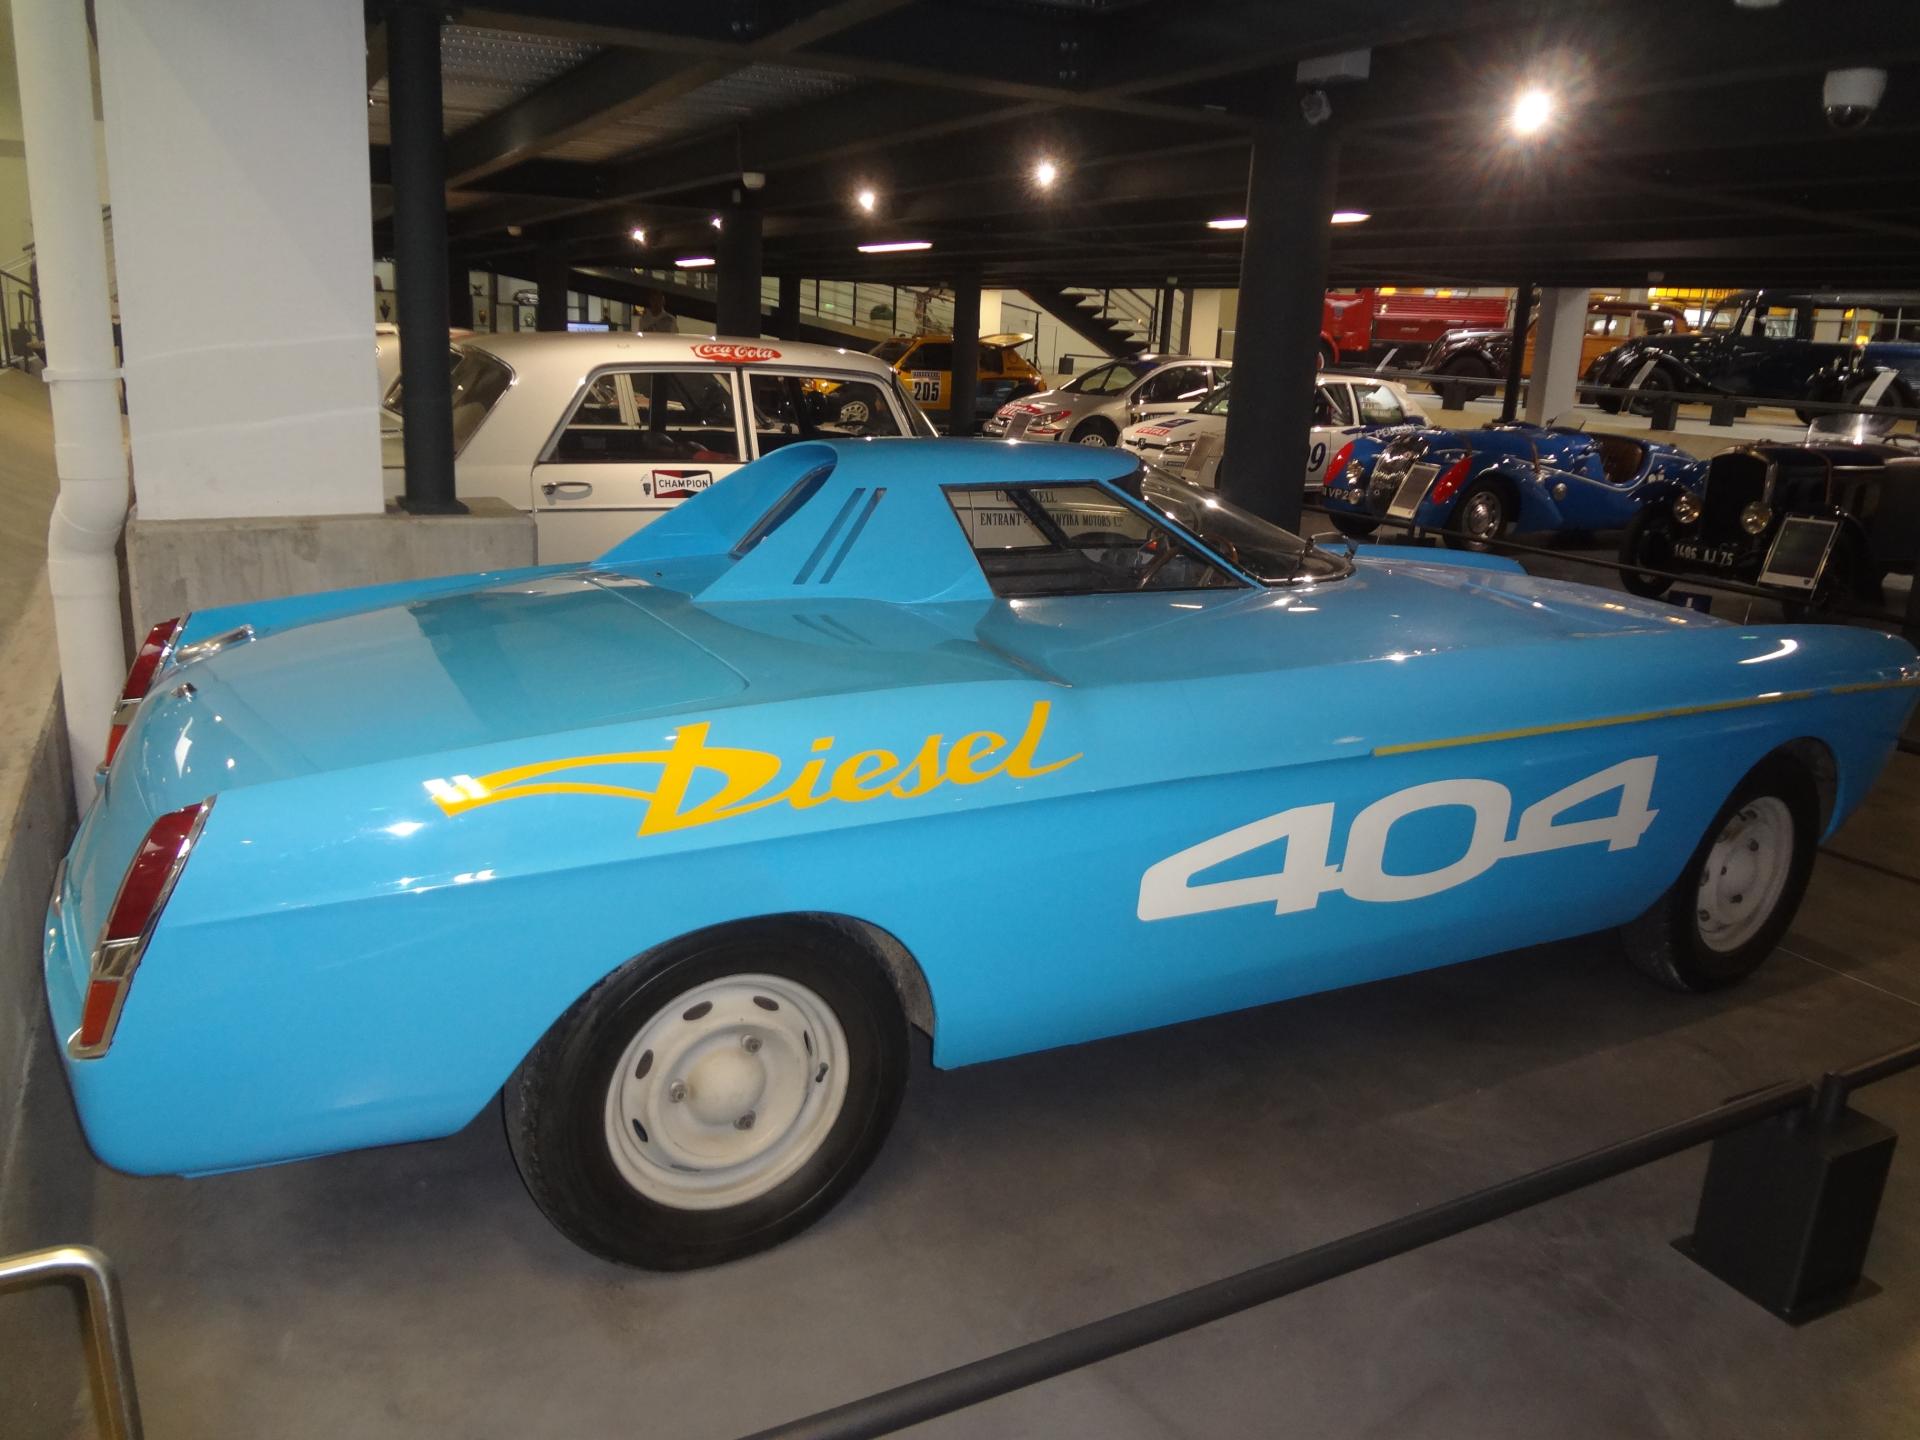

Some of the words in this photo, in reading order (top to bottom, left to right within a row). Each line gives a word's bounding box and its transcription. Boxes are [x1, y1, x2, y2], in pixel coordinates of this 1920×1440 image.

[914, 381, 940, 401] 205
[1306, 442, 1326, 473] 9
[658, 479, 709, 489] CHAMPION
[1082, 514, 1111, 527] MOTORS
[637, 701, 1083, 838] Diesel
[1137, 755, 1660, 922] 404
